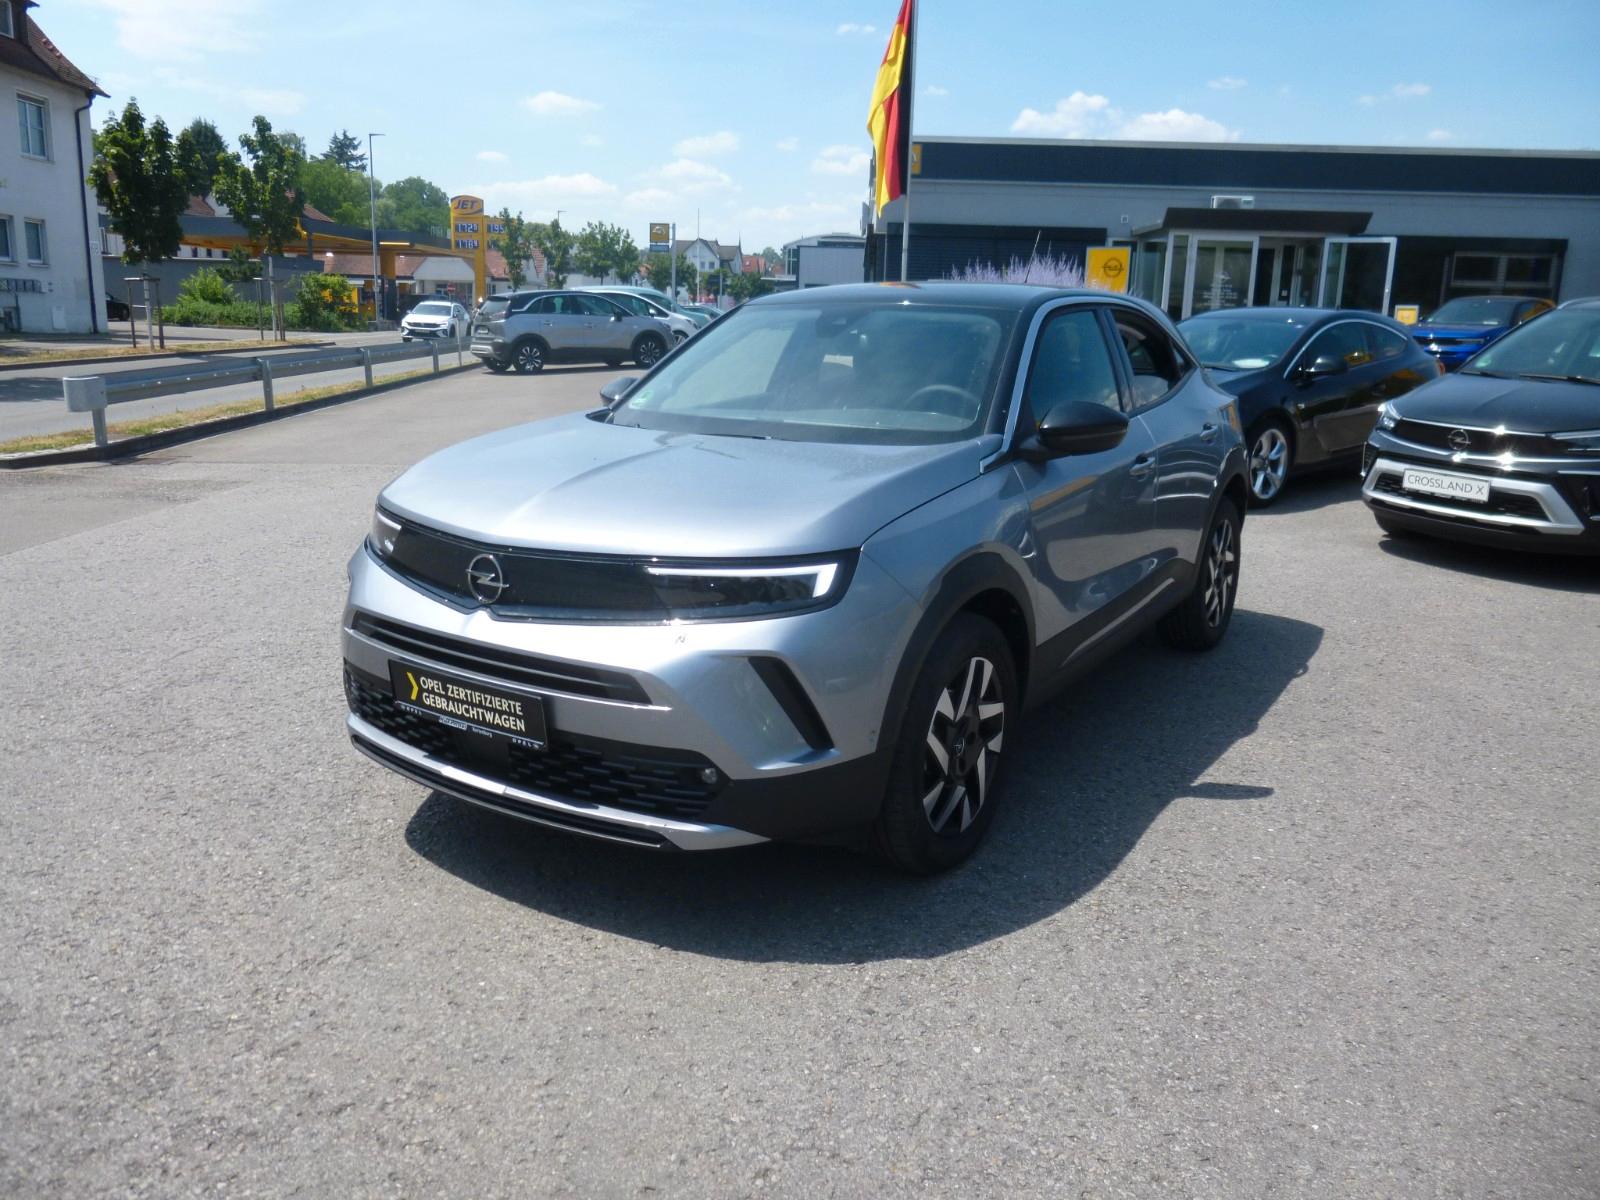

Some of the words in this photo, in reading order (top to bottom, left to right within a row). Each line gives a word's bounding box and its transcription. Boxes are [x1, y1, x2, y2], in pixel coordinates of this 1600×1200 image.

[455, 199, 480, 210] JET
[1407, 474, 1473, 494] CROSSLAND
[1475, 485, 1485, 495] X
[420, 676, 445, 695] OPEL
[446, 684, 524, 716] ZERTIFIZIERTE
[422, 692, 526, 732] GEBRAUCHTWAGEN
